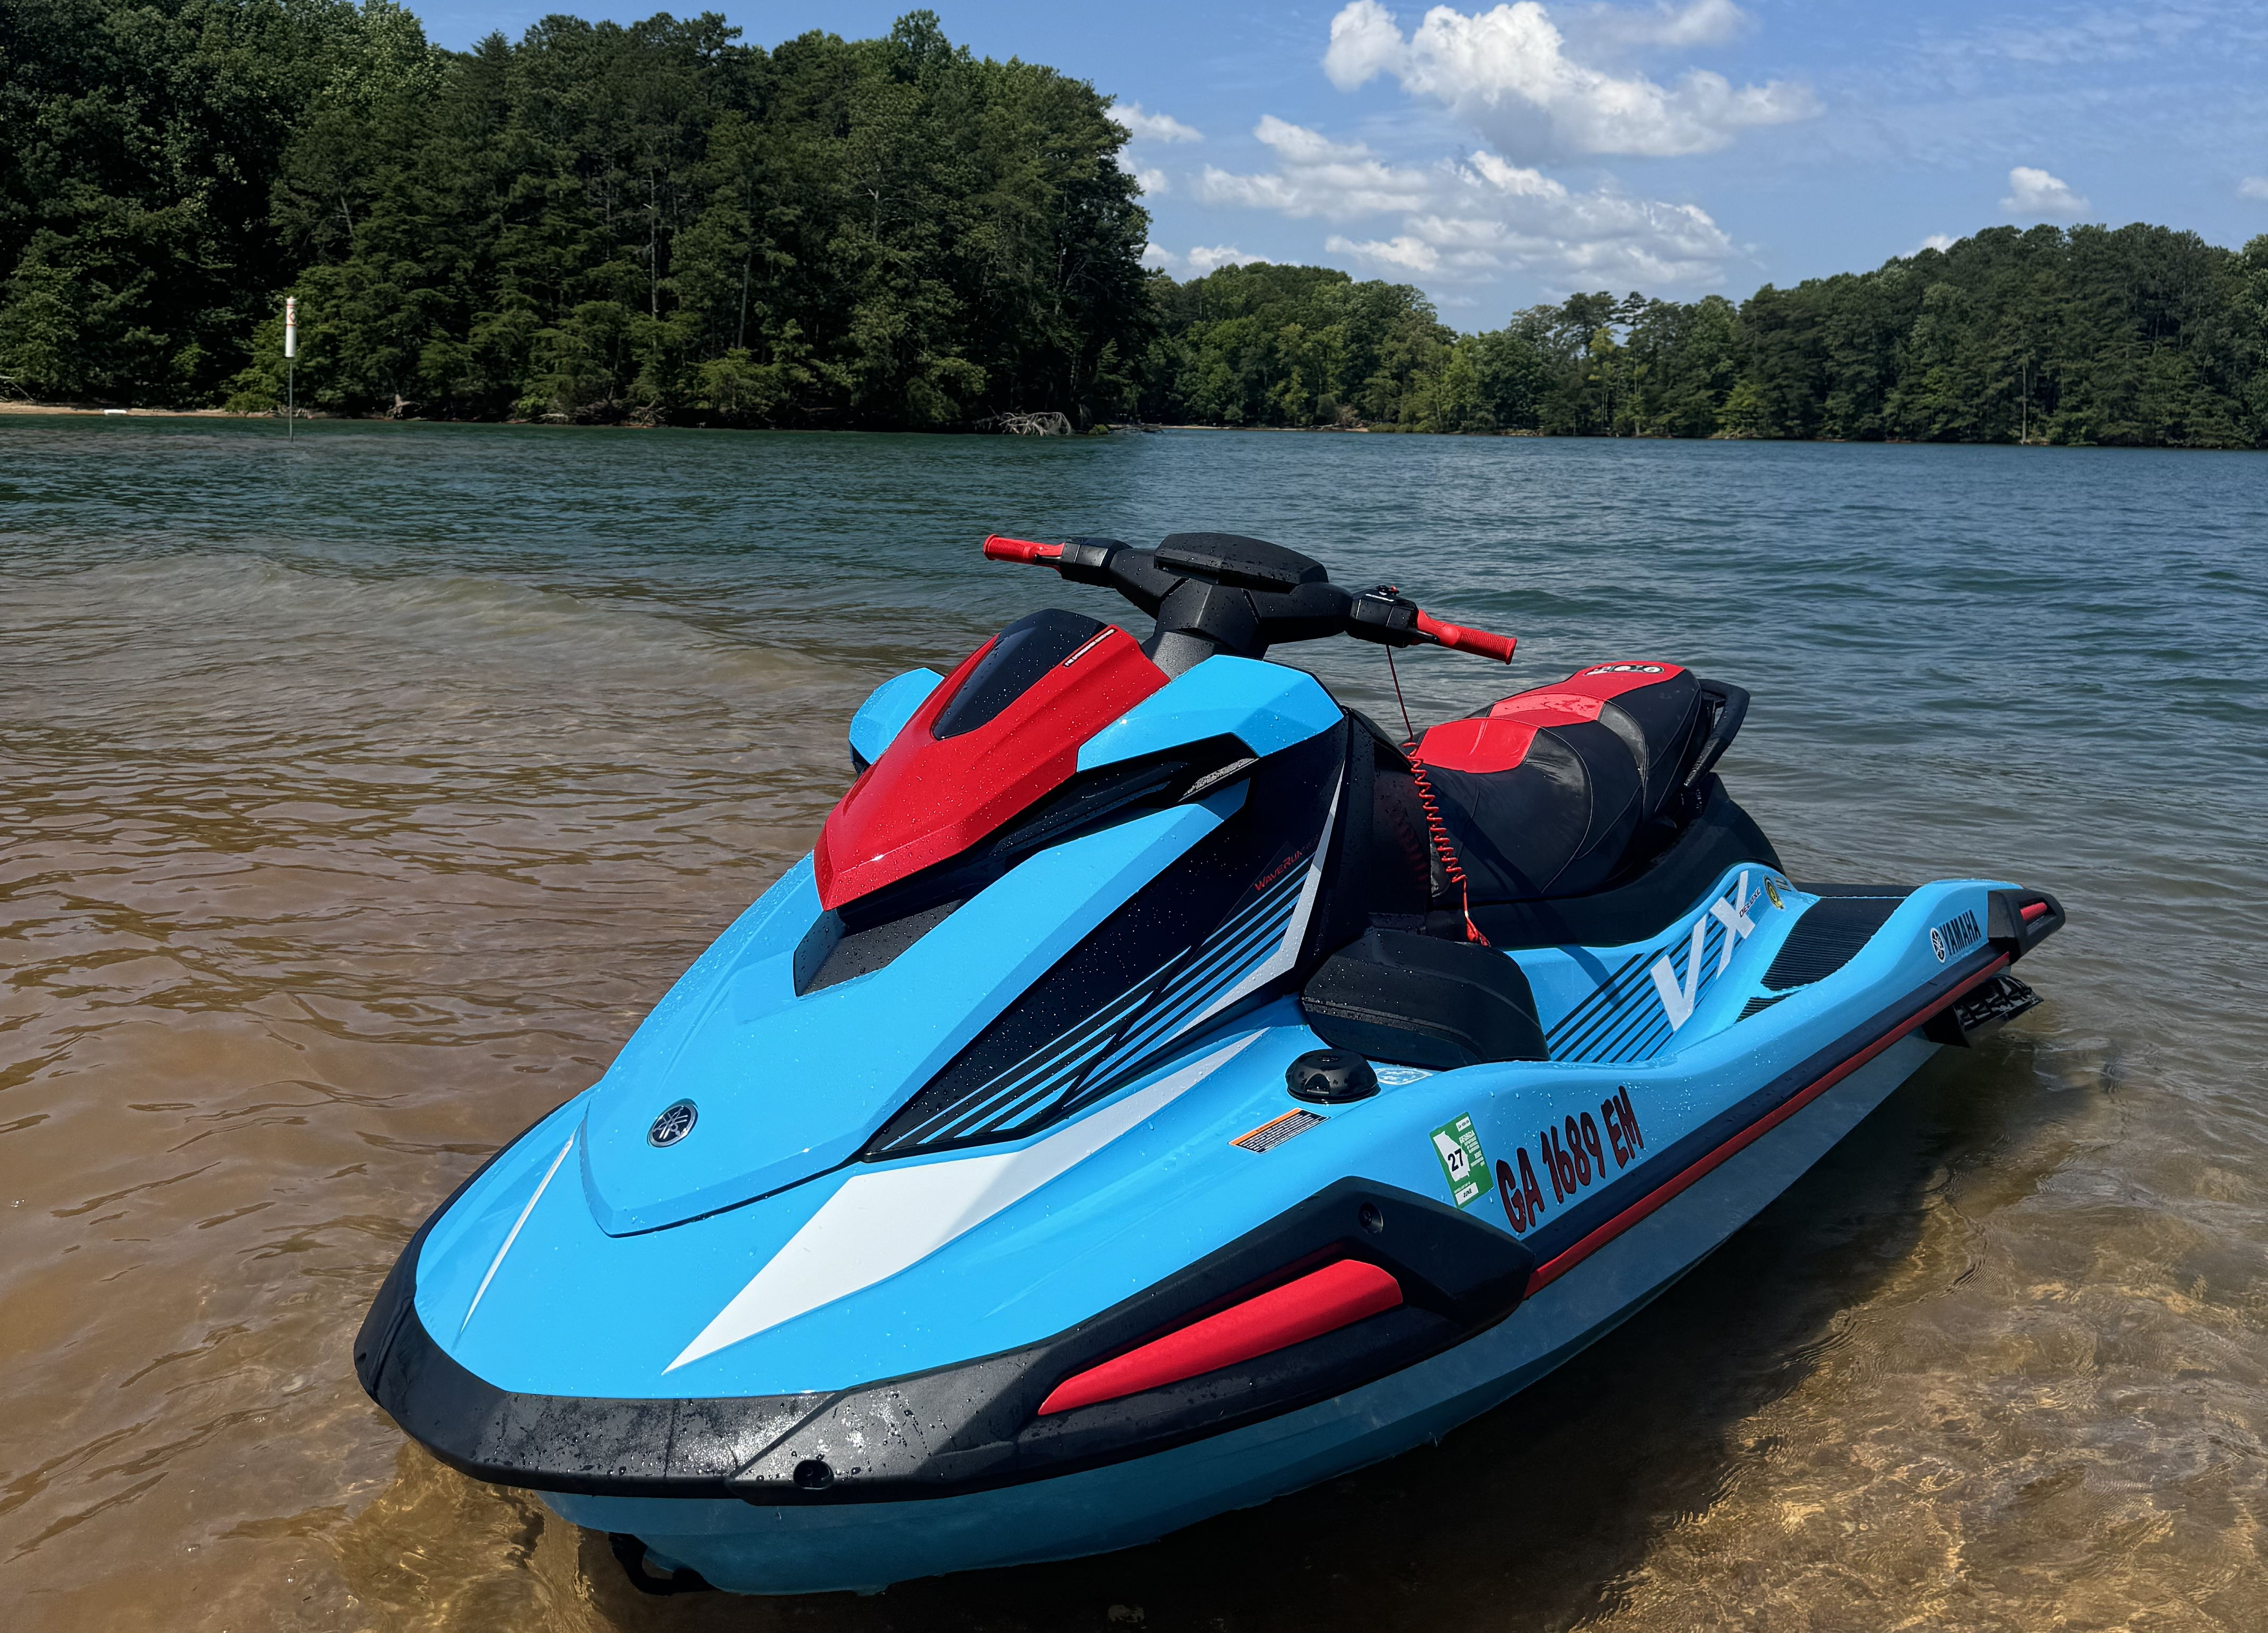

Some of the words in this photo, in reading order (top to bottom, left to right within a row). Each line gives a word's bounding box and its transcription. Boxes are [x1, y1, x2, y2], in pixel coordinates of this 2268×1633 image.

[1254, 834, 1319, 891] WAVERUN
[1650, 870, 1755, 1031] VX
[1938, 909, 1981, 956] YAMAHA
[1448, 1148, 1463, 1172] 27
[1496, 1147, 1545, 1233] GA
[1540, 1112, 1605, 1204] 1689
[1601, 1084, 1644, 1169] EM
